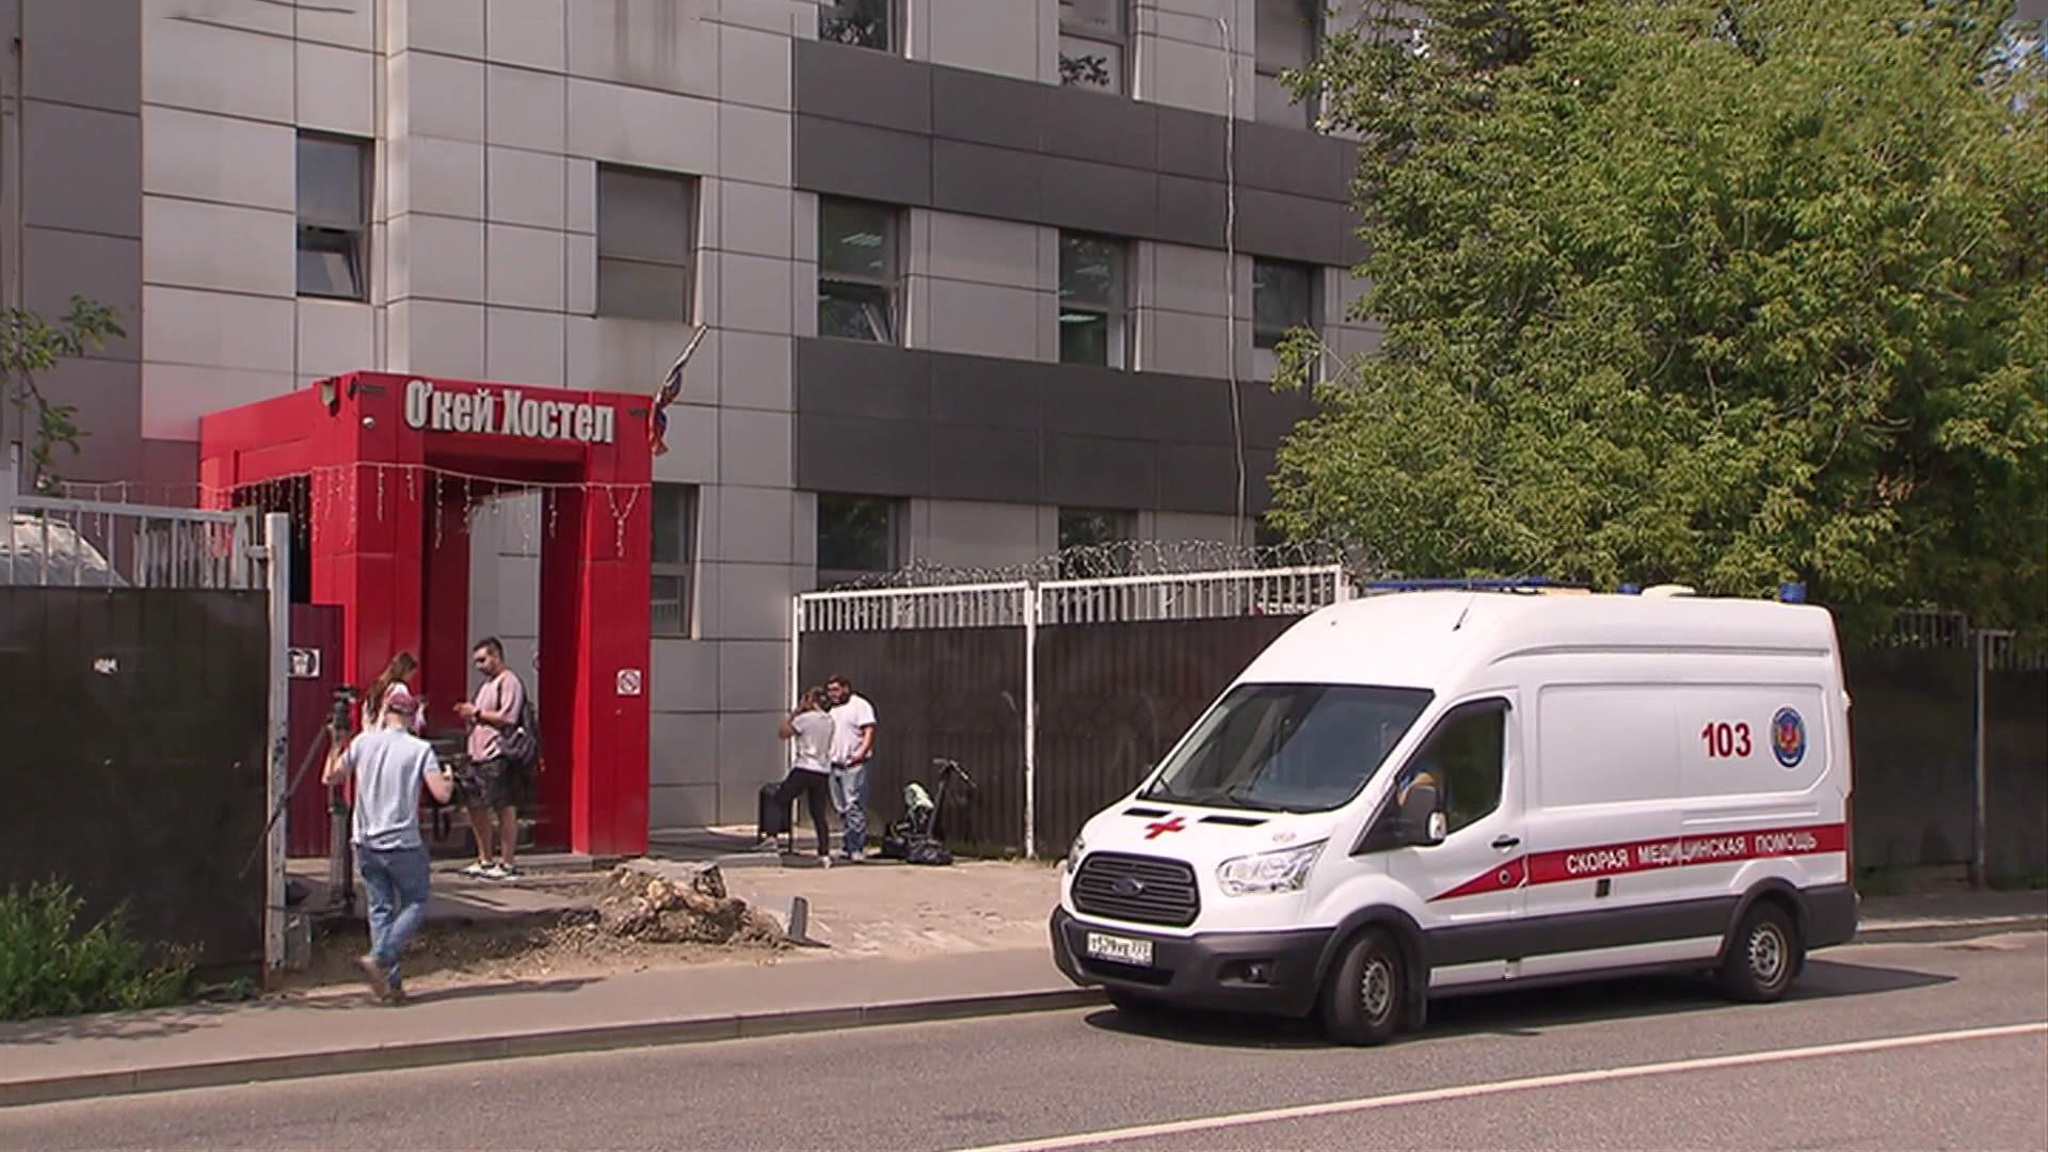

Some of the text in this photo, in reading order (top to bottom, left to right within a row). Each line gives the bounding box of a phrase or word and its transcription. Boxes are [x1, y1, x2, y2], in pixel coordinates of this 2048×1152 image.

[501, 389, 615, 443] Хостел
[1702, 722, 1751, 758] 103
[1566, 831, 1818, 874] СКОРАЯ МЕДИЦИНСКАЯ ПОМОЩЬ
